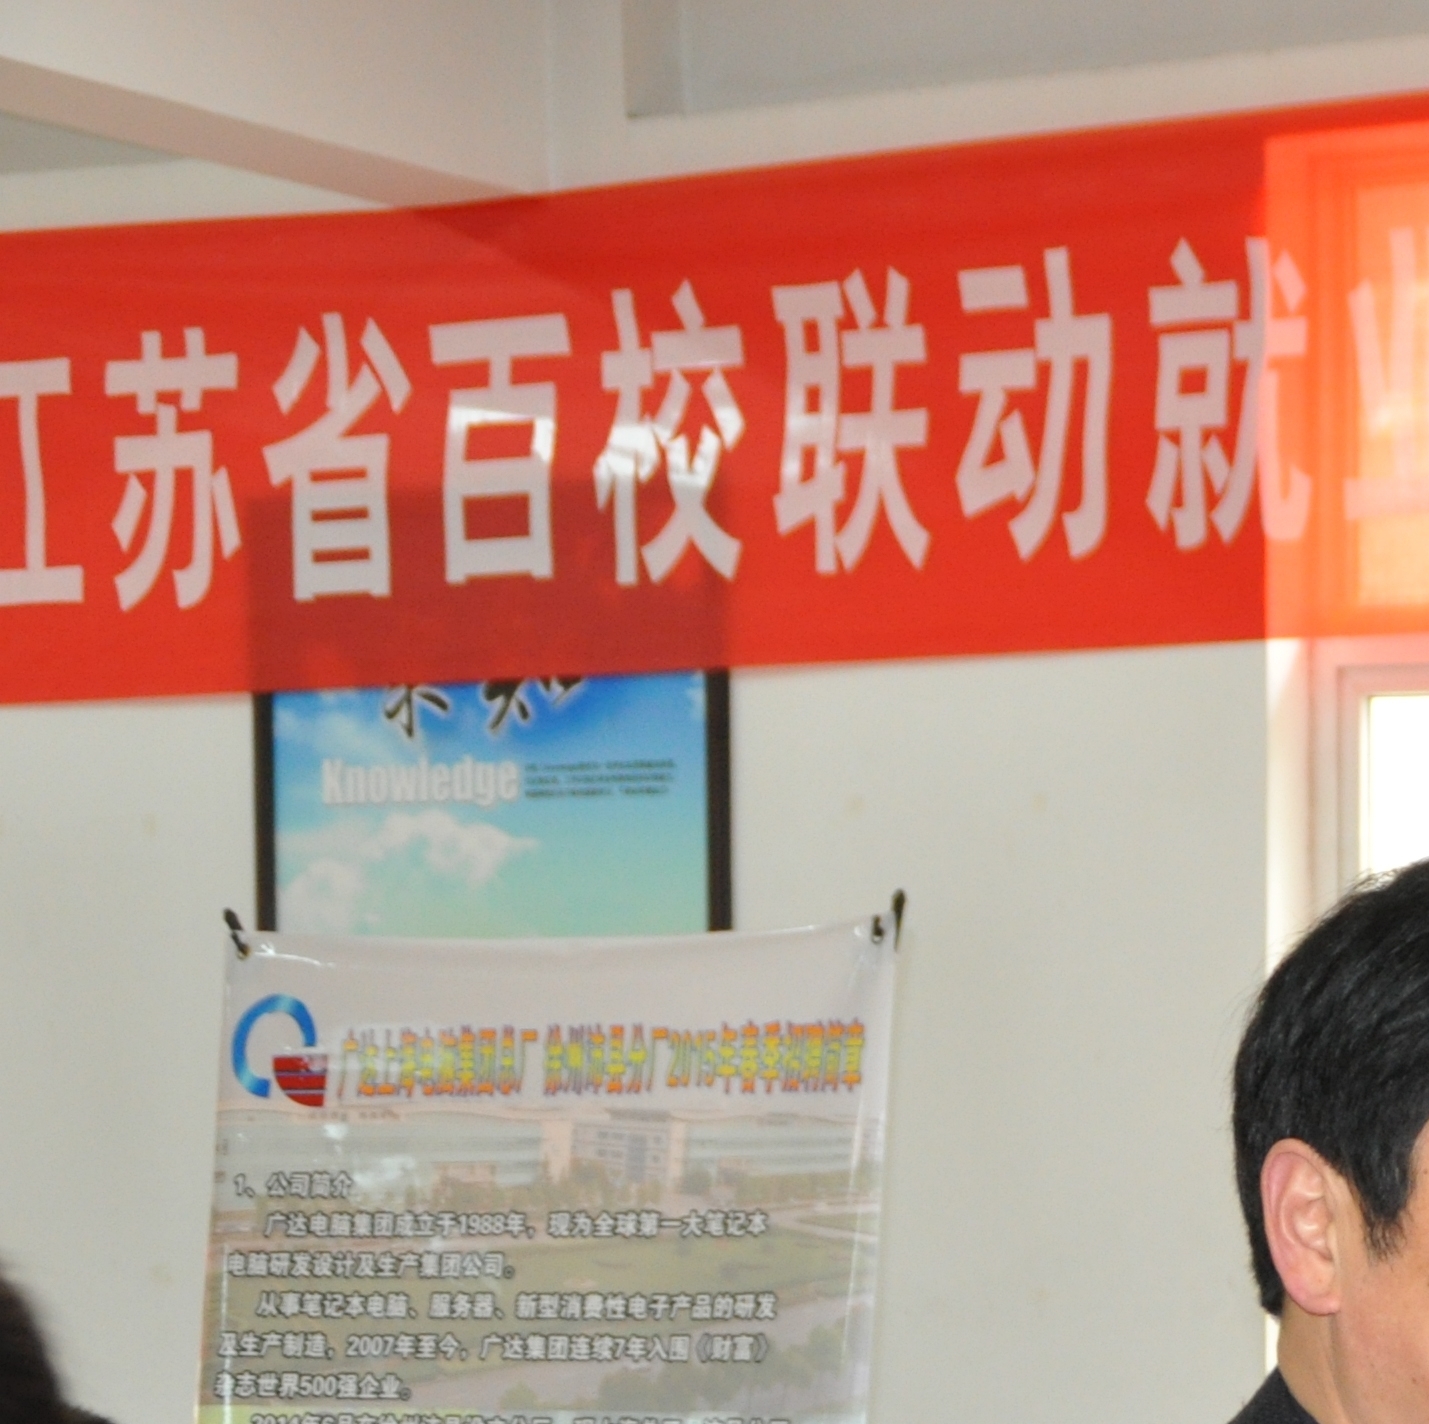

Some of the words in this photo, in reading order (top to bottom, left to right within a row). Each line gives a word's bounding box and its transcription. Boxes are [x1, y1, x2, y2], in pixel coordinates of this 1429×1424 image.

[322, 754, 521, 807] Knowledge
[234, 1170, 355, 1199] 1、公司简介
[263, 1210, 769, 1240] 广达电脑集团成立于1988年，现为全球第一大笔记本
[226, 1251, 516, 1280] 电脑研发设计及生产集团公司。
[255, 1289, 779, 1321] 从事笔记本电脑、服务器、新型消费性电子产品的研发
[212, 1371, 412, 1400] 杂志世界500强企业。
